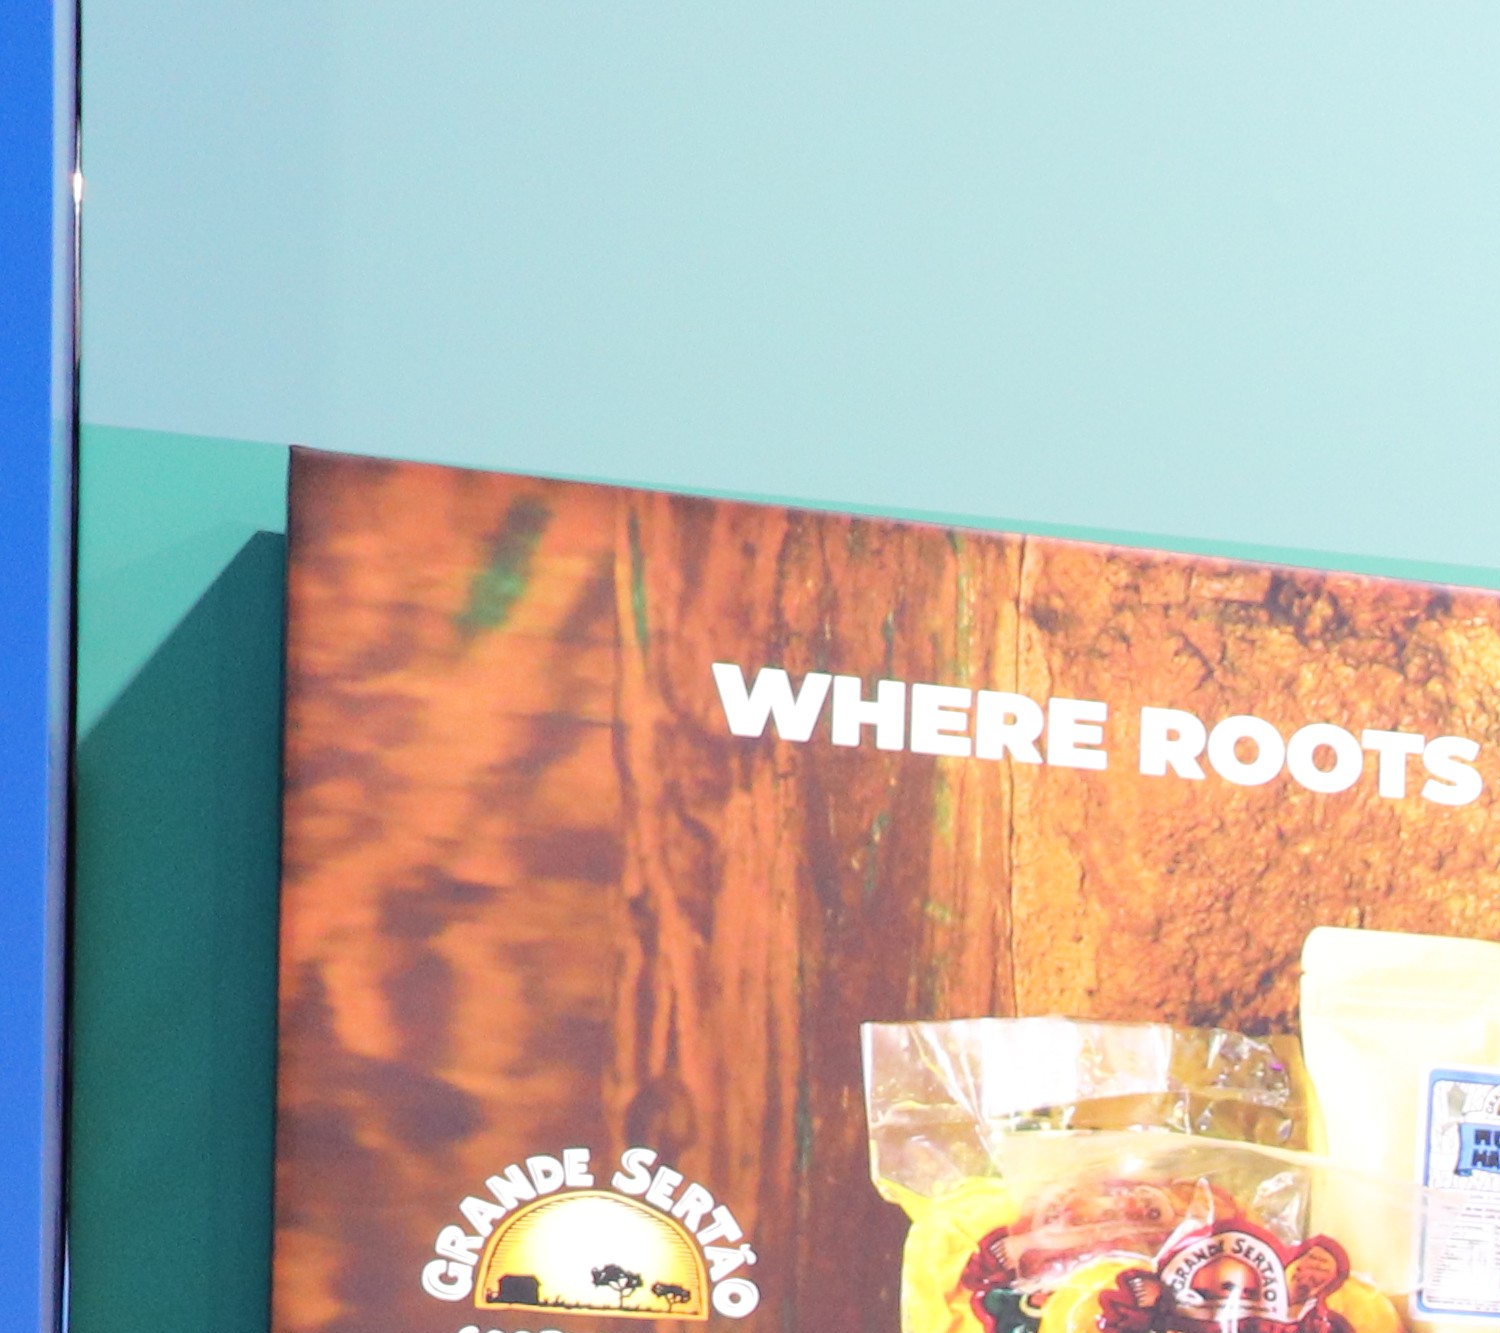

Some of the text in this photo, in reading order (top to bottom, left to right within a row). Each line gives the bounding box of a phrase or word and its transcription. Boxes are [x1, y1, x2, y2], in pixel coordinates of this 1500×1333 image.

[711, 661, 1108, 771] WHERE
[1138, 706, 1483, 807] ROOTS
[421, 1147, 760, 1319] GRANDE SERTÃO
